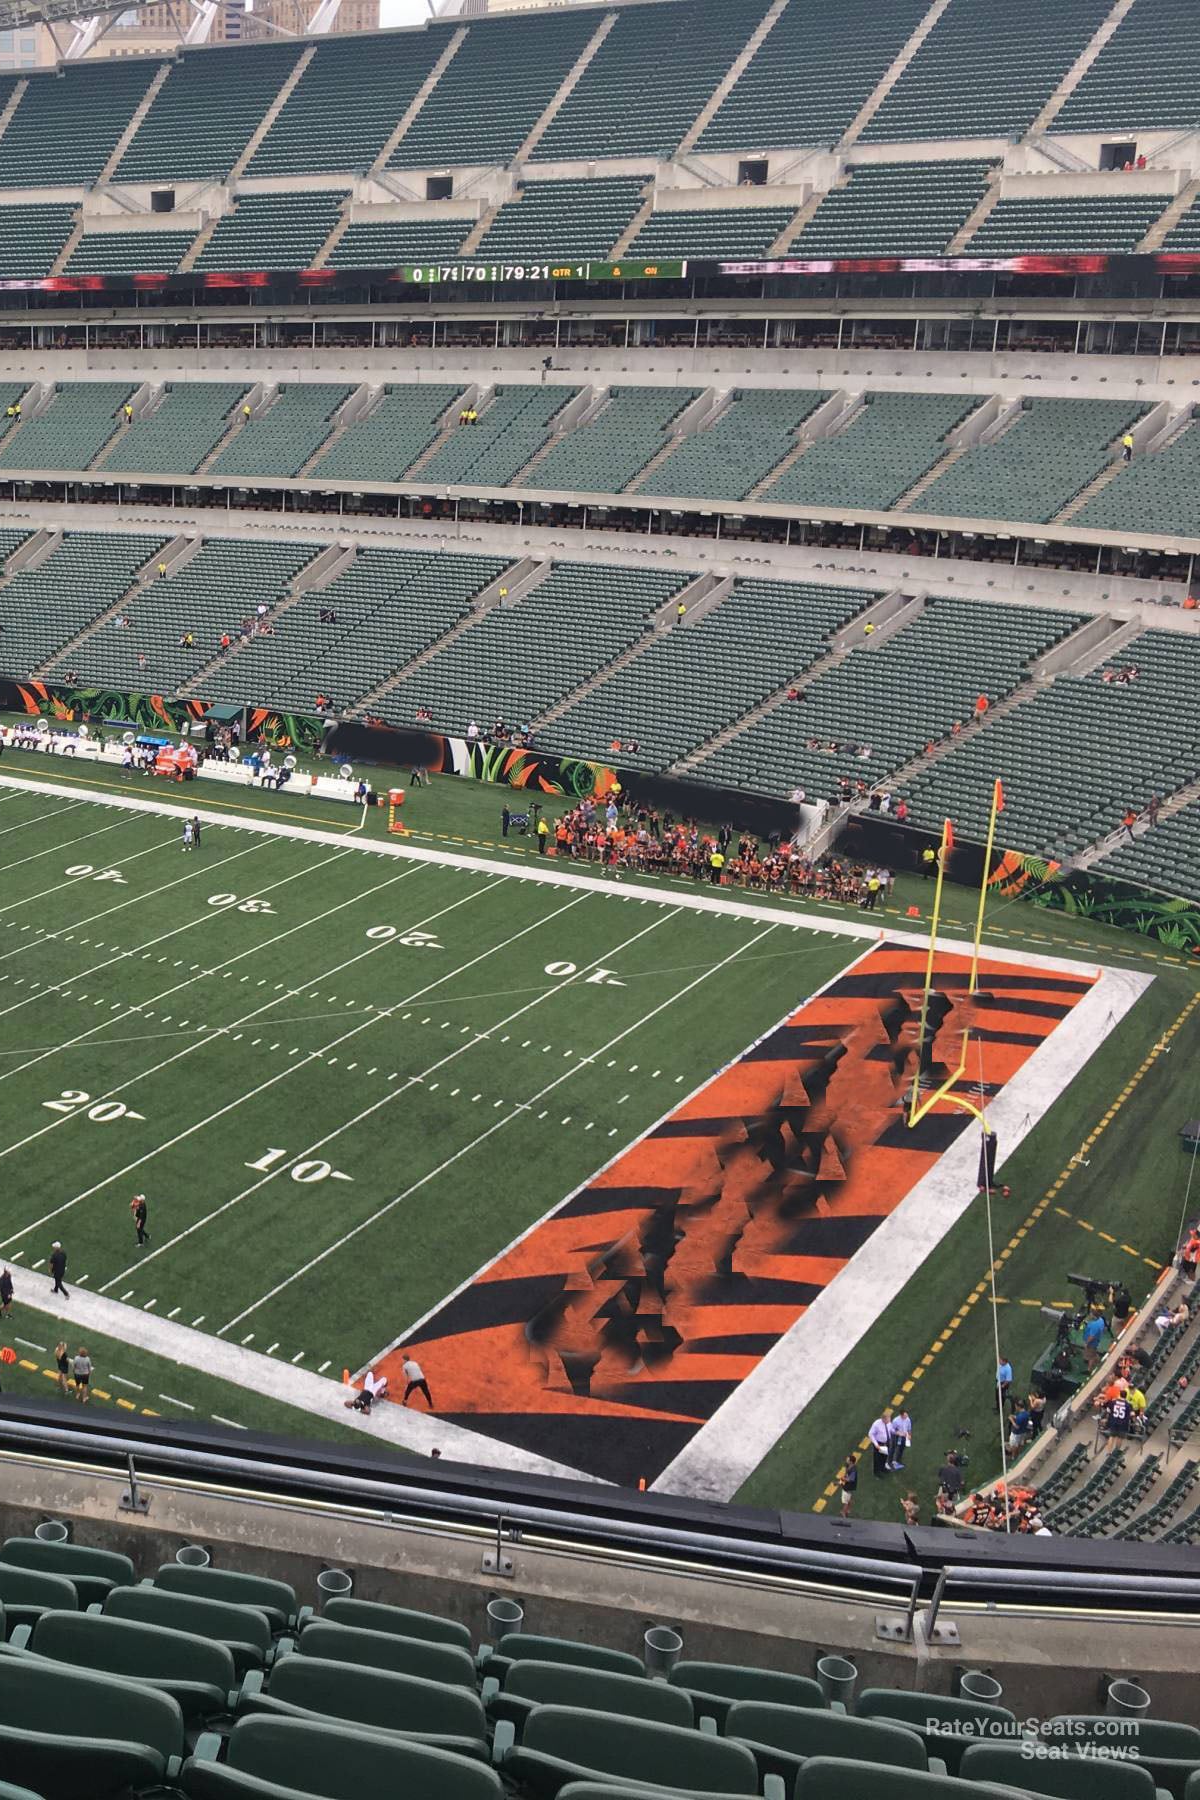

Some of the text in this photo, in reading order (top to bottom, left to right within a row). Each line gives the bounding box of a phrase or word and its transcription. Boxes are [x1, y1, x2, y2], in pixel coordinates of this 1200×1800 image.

[413, 269, 422, 282] 0
[465, 266, 486, 280] 70
[505, 265, 549, 280] 79:21
[552, 269, 571, 277] QTR
[576, 266, 583, 276] 1
[42, 1090, 127, 1122] 20
[244, 1147, 332, 1183] 10
[1113, 1405, 1126, 1419] 55
